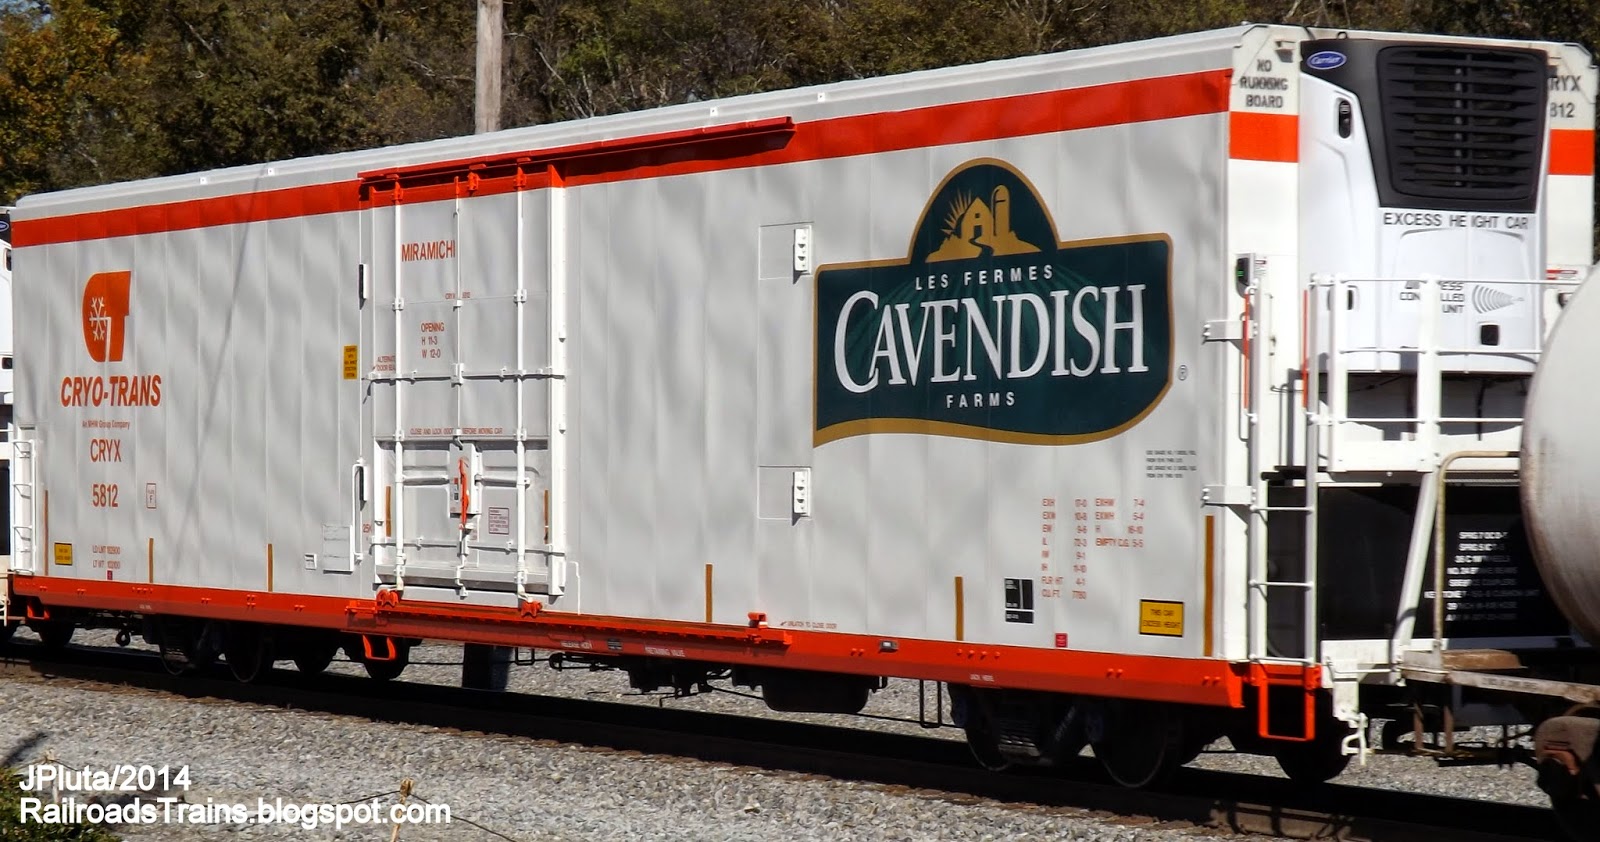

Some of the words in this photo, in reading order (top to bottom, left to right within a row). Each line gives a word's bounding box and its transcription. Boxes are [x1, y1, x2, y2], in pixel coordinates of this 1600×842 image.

[1256, 59, 1272, 72] NO
[1239, 76, 1289, 90] RUNNING
[1549, 75, 1582, 91] RYX
[1245, 94, 1283, 108] BOARD
[1383, 212, 1442, 226] EXCESS
[1505, 216, 1528, 230] CAR
[401, 240, 456, 262] MIRAMICHI
[915, 273, 949, 291] LES
[964, 264, 1053, 287] FERMES
[1442, 304, 1465, 314] UNIT
[420, 322, 445, 333] OPENING
[421, 336, 426, 346] H
[428, 336, 438, 345] 11-3
[833, 284, 1149, 394] CAVENDISH
[422, 349, 427, 359] W
[430, 349, 441, 359] 12-0
[60, 374, 162, 408] CRYO-TRANS
[946, 391, 1016, 409] FARMS
[90, 438, 122, 462] CRYX
[92, 484, 118, 508] 5812
